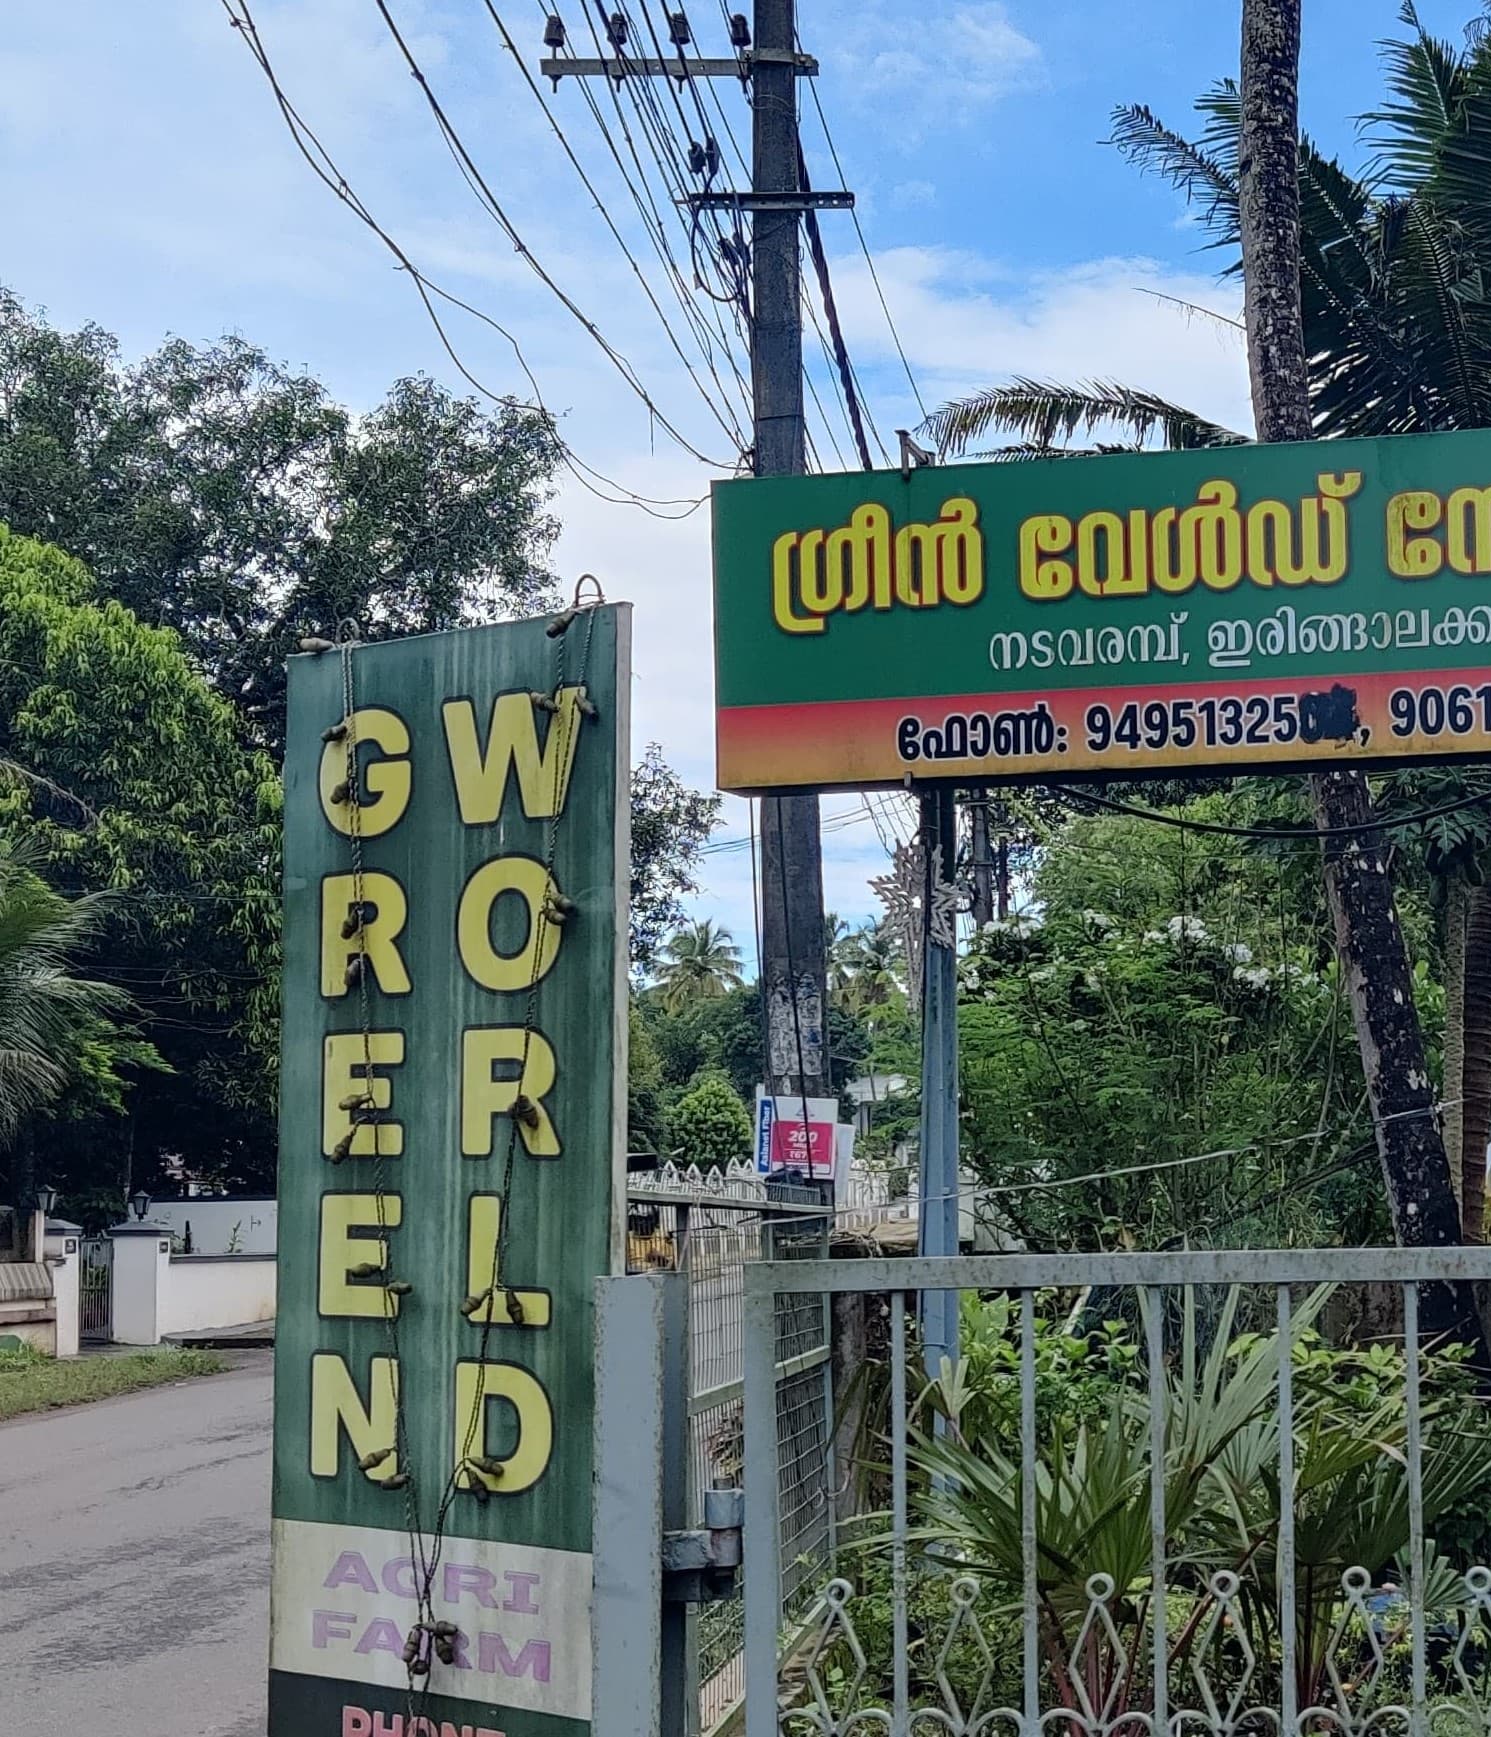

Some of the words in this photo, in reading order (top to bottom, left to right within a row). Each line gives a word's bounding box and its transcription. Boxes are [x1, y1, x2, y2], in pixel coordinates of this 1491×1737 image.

[772, 497, 983, 634] ഗ്രീൻ
[1019, 470, 1362, 600] വേൾഡ്
[988, 611, 1190, 671] നടവരമ്പ്,
[1085, 683, 1371, 751] 94951325,
[309, 706, 413, 1482] GREEN
[442, 685, 586, 1493] WORLD
